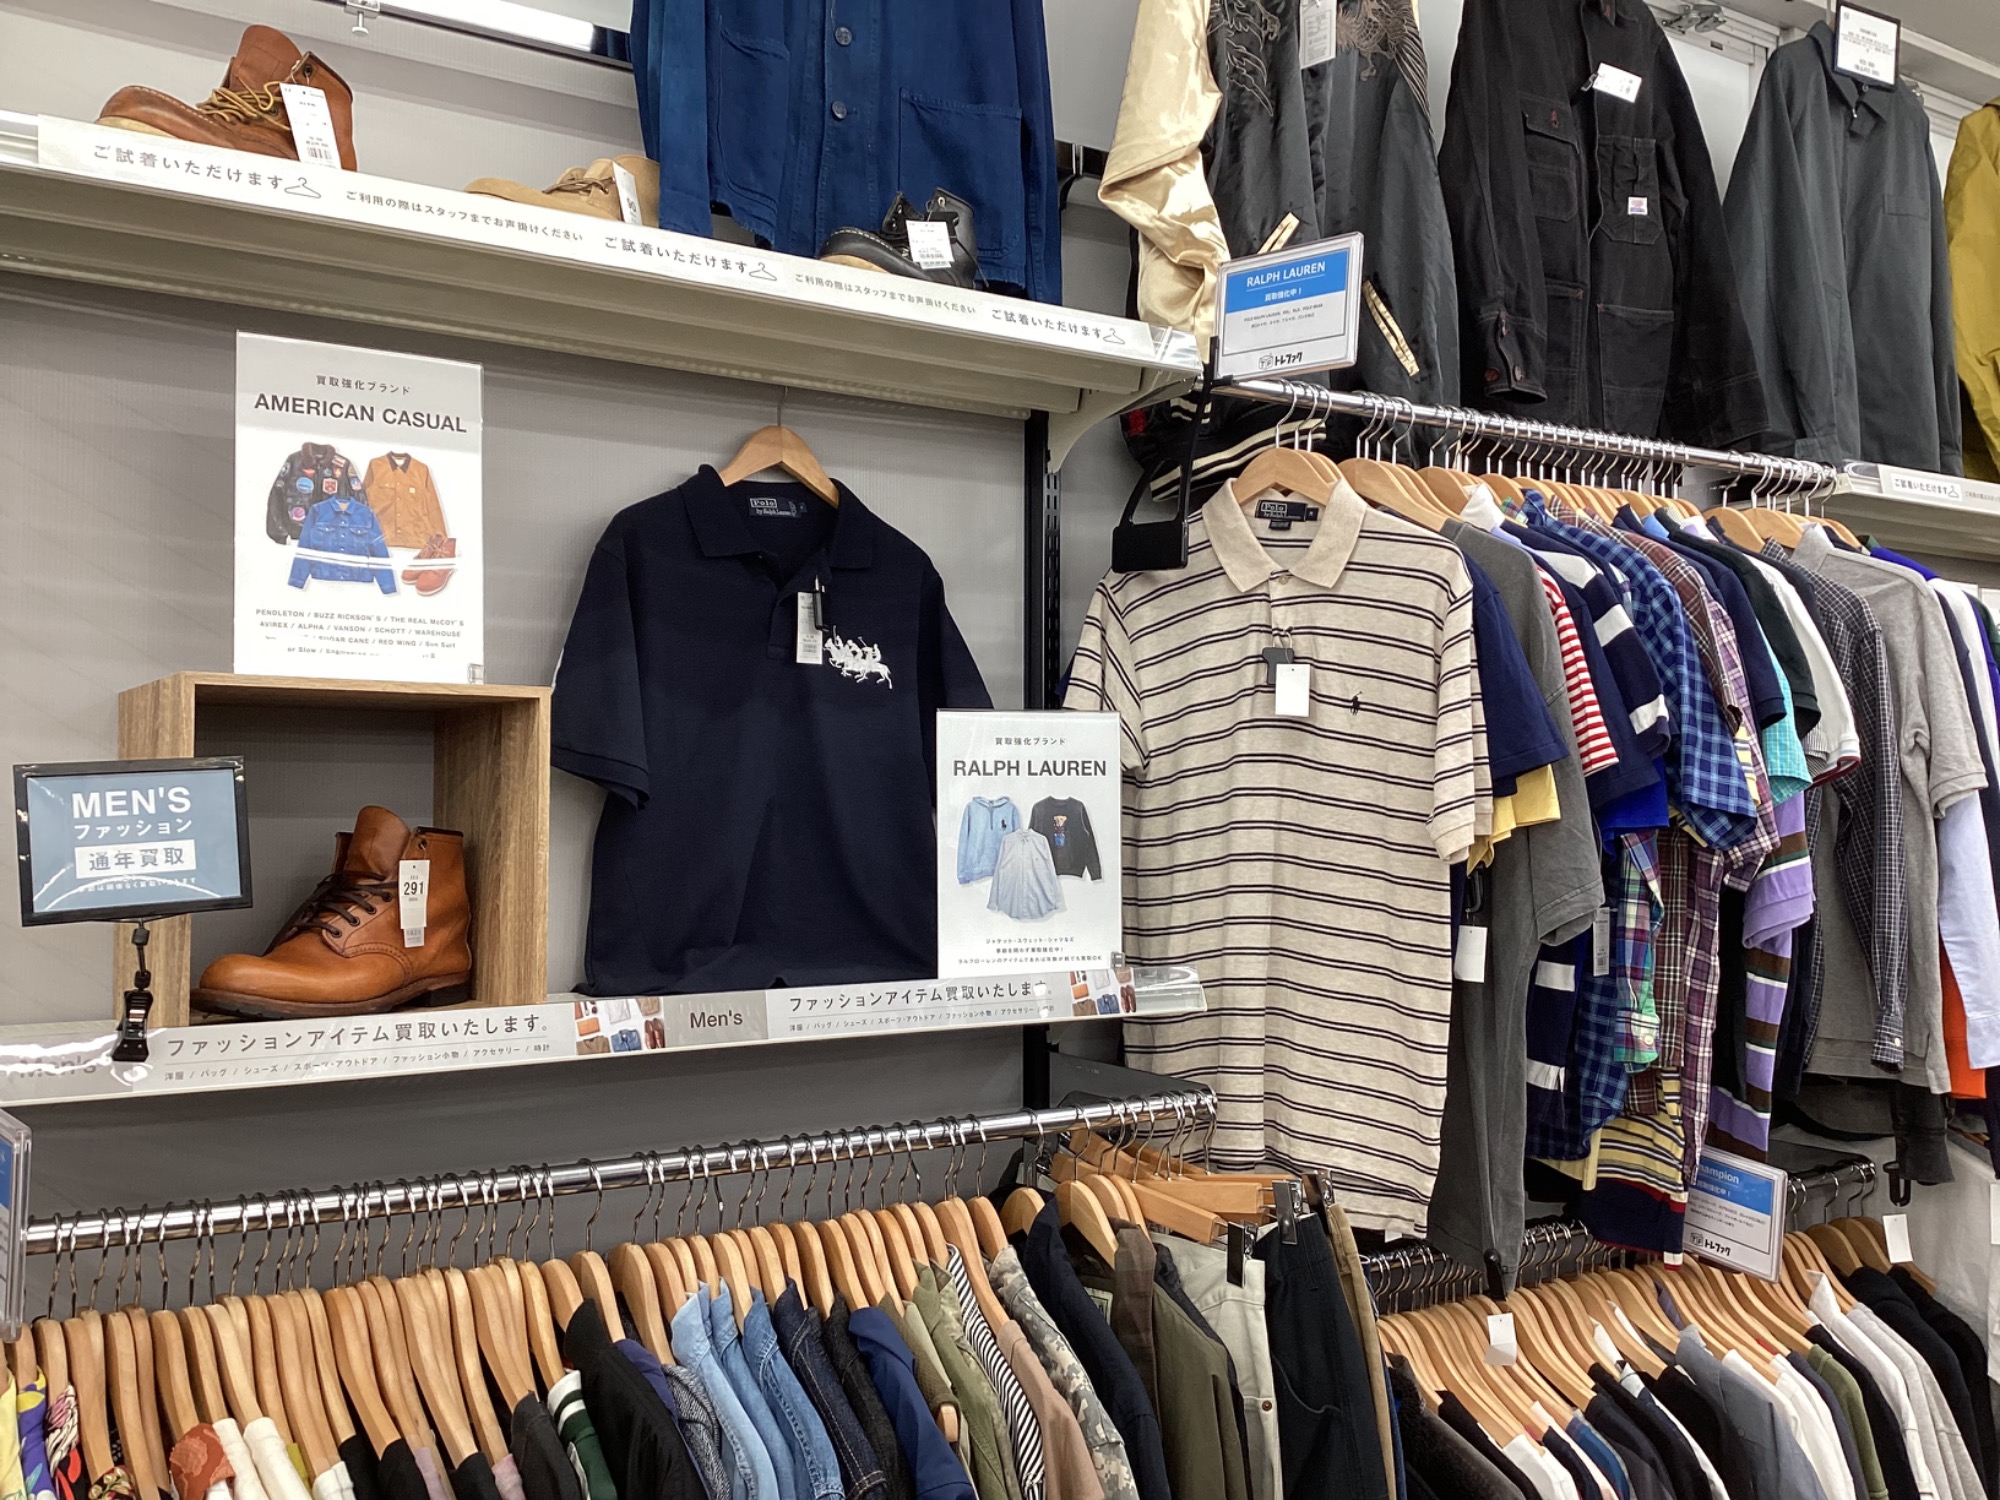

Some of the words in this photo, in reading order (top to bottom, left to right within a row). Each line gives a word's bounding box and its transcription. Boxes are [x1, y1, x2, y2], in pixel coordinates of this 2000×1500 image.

[94, 145, 283, 189] ご試着いただけます
[346, 190, 583, 241] ご利用の際はスタッフまでお声掛けください
[605, 236, 747, 273] ご試着いただけます
[1246, 271, 1280, 287] RALPH
[1283, 261, 1326, 280] LAUREN
[991, 308, 1102, 339] ご試着いただけます
[316, 375, 411, 395] 買取強化ブランド
[254, 393, 375, 422] AMERICAN
[382, 408, 467, 433] CASUAL
[256, 609, 305, 617] PENDLETON
[260, 621, 288, 629] AVIREX
[414, 629, 462, 637] WAREHOUSE
[995, 737, 1066, 746] 買取強化ブランド
[953, 760, 1020, 776] RALPH
[1027, 760, 1107, 777] LAUREN
[71, 786, 192, 819] MEN'S
[74, 818, 192, 840] ファッション
[88, 847, 185, 872] 通年買取
[403, 881, 424, 896] 291
[790, 980, 1052, 1012] ファッションアイテム買取いたしま。
[690, 1010, 744, 1029] Men's
[843, 1019, 867, 1027] シューズ
[168, 1014, 547, 1056] ファッションアイテム買取いたします。
[165, 1071, 184, 1081] 洋服
[200, 1068, 227, 1078] バッグ
[244, 1064, 278, 1074] シューズ
[393, 1051, 459, 1063] ファッション小物
[473, 1046, 520, 1057] アクセサリー
[534, 1044, 550, 1052] 時計
[1700, 1164, 1739, 1184] ampion
